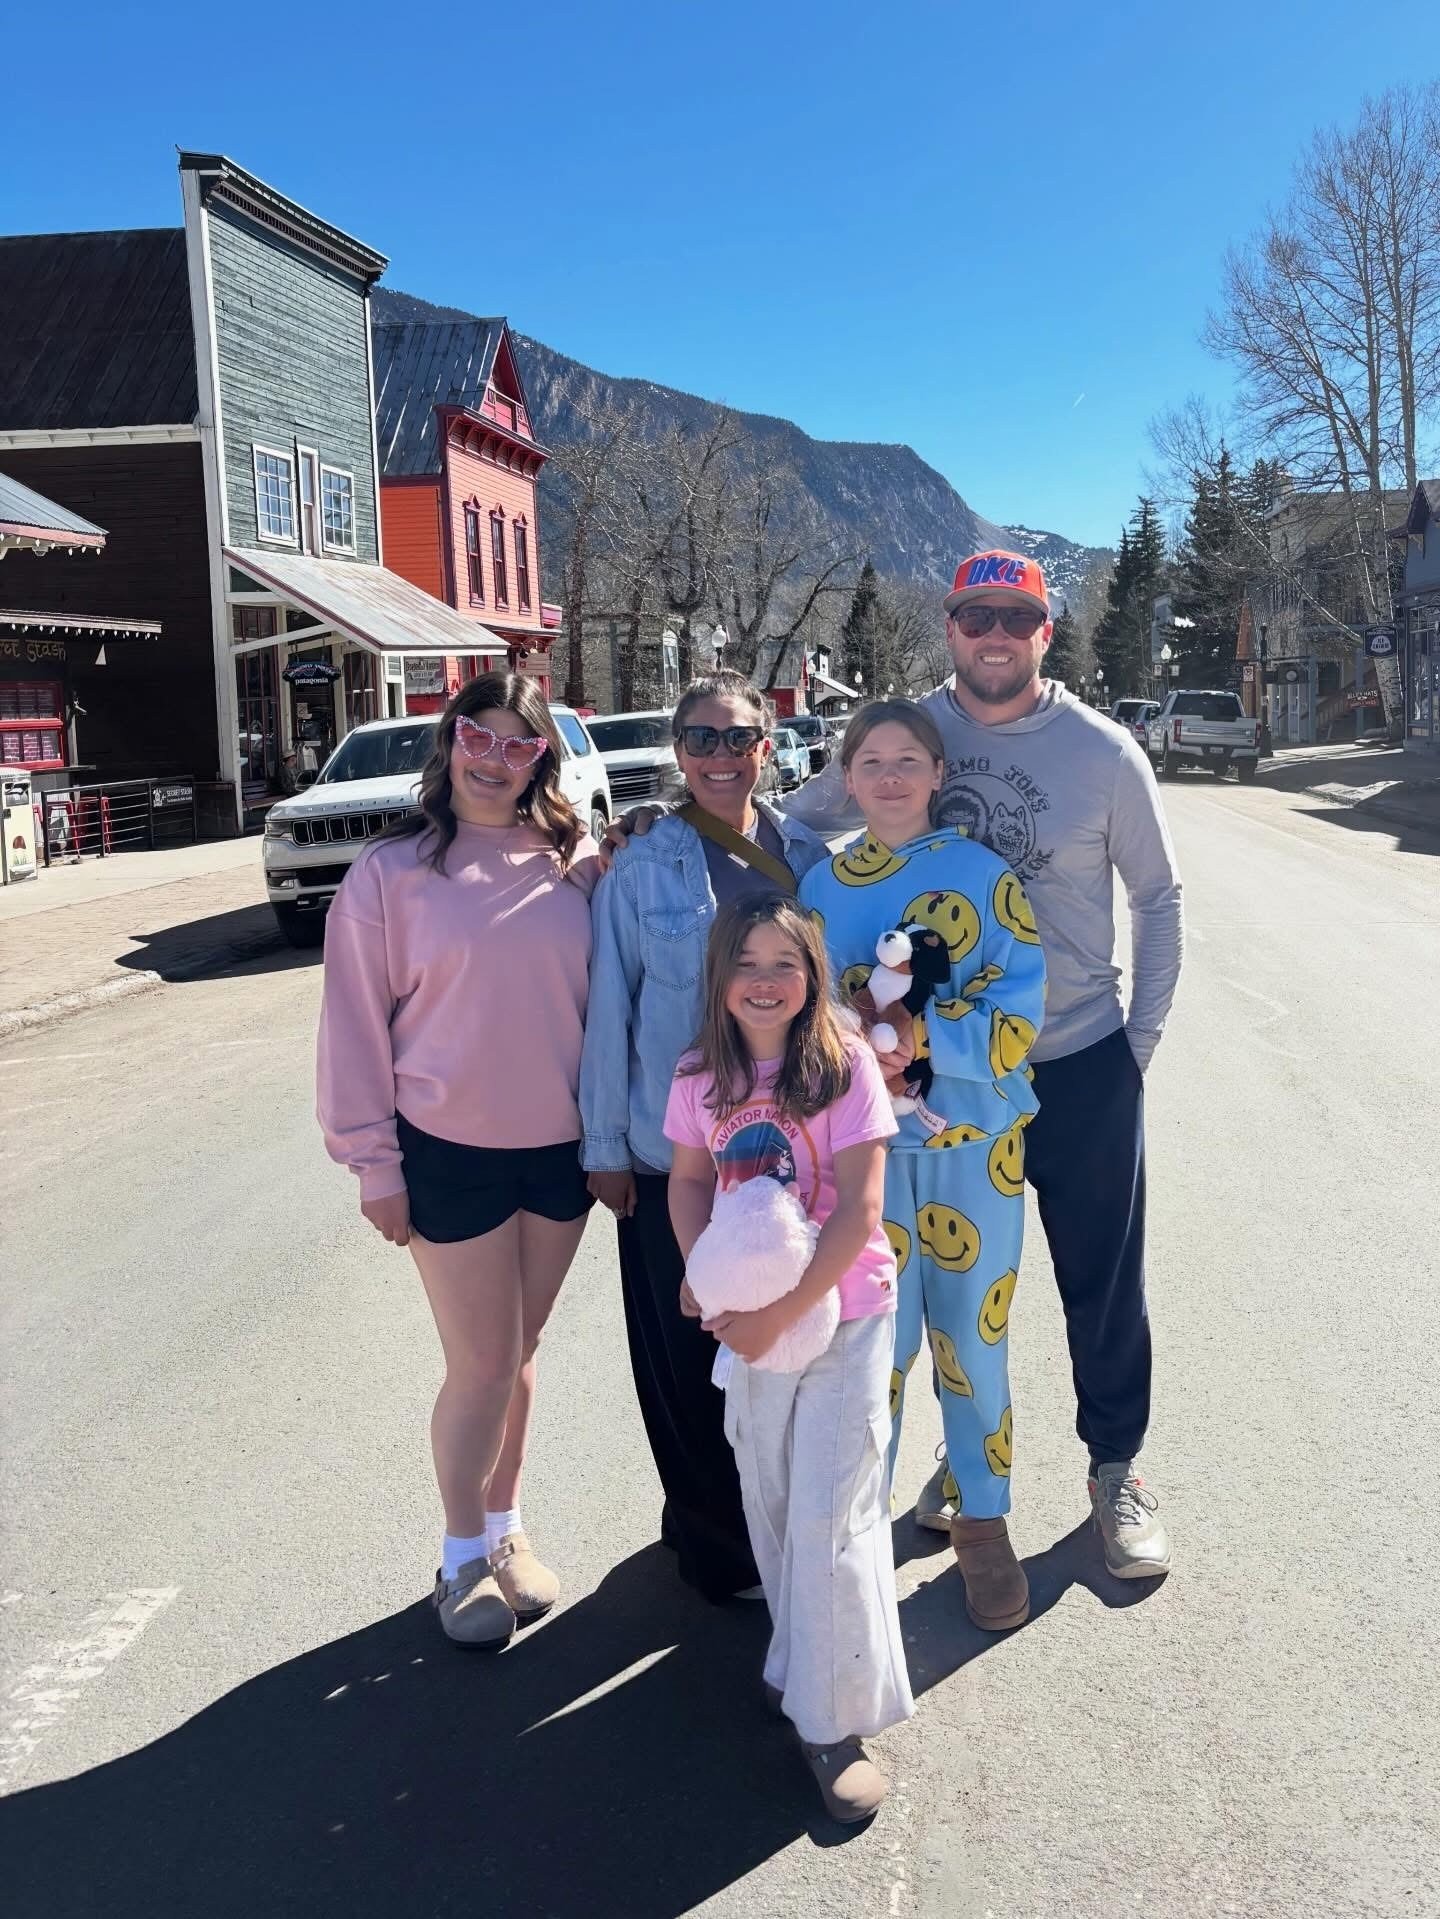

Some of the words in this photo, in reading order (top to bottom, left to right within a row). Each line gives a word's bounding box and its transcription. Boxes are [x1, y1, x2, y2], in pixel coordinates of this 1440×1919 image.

[966, 556, 1026, 586] OKC
[295, 677, 329, 686] patagonia
[945, 756, 990, 778] IMO
[716, 1108, 761, 1149] AVIATOR
[764, 1107, 799, 1140] NAON
